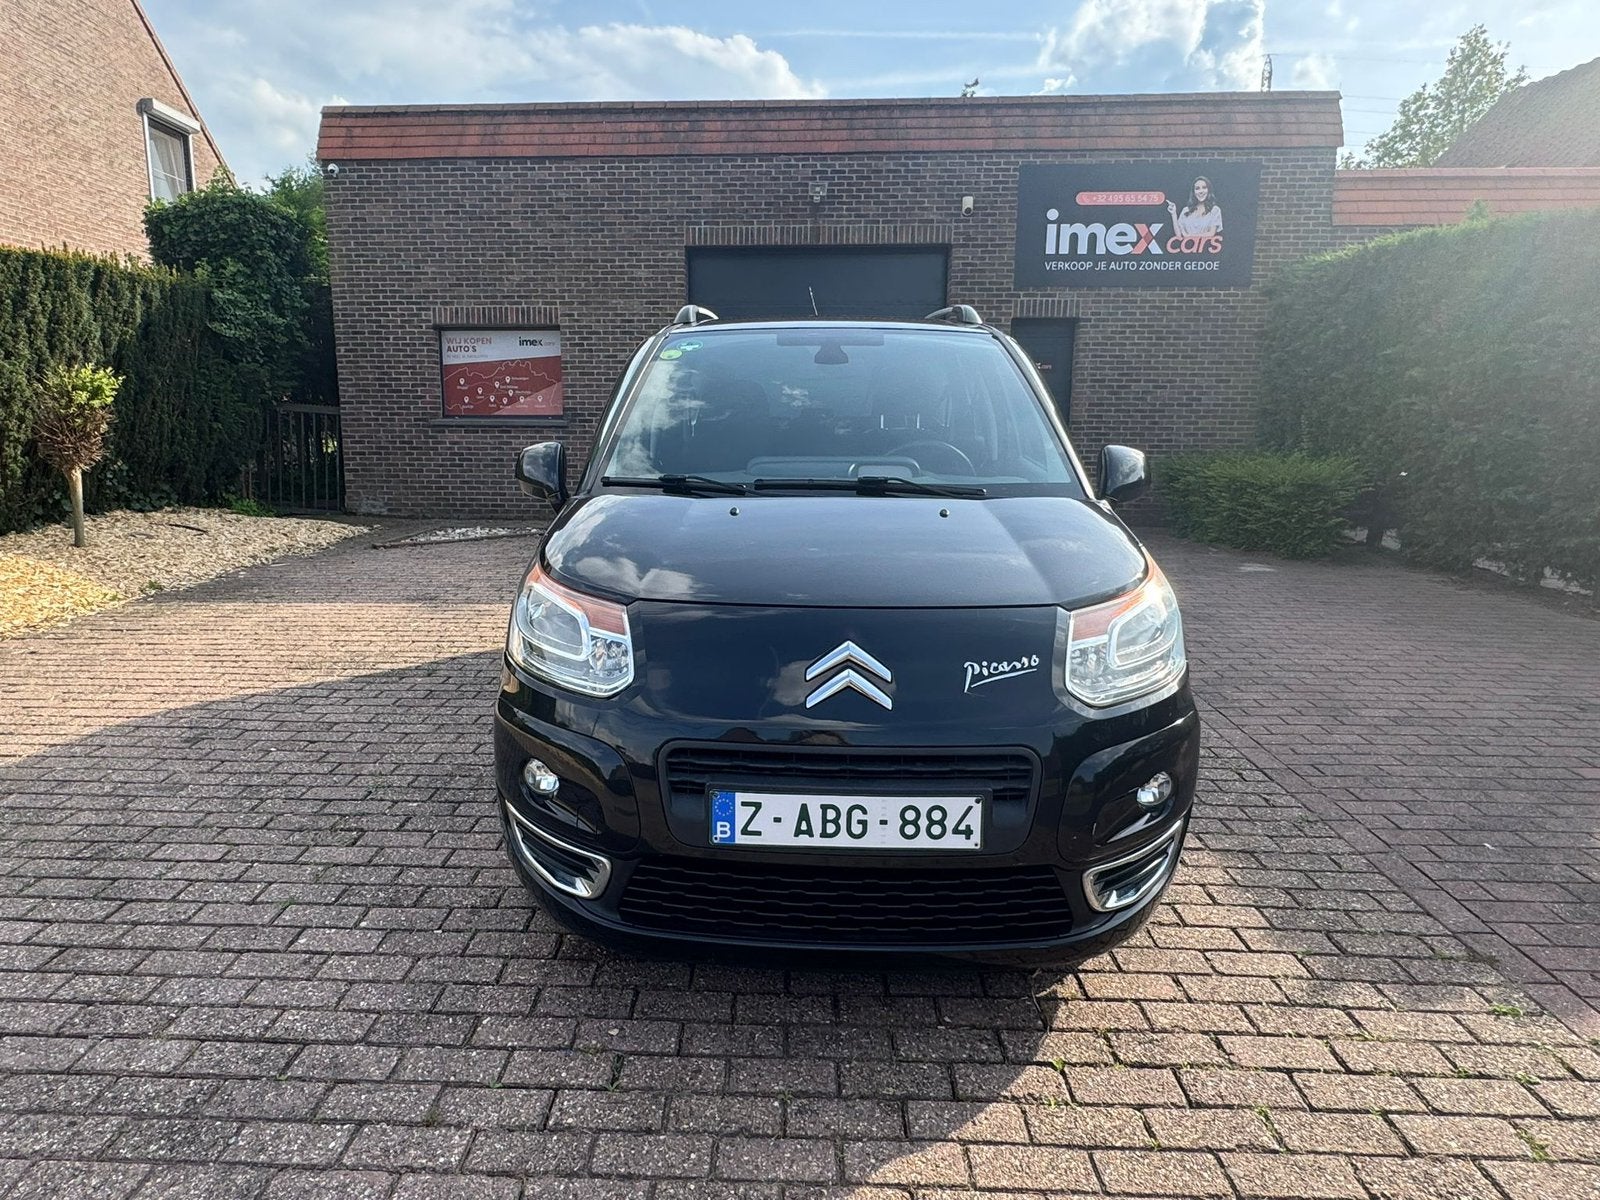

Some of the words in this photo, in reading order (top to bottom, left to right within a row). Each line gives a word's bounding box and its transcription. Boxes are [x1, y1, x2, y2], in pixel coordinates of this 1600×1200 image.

[1045, 208, 1164, 256] imex
[1166, 235, 1224, 254] cars
[1045, 261, 1093, 271] VERKOOP
[1095, 261, 1107, 271] JE
[1109, 261, 1137, 271] AUTO
[1139, 261, 1180, 271] ZONDER
[1183, 261, 1220, 271] GEDOE
[446, 337, 462, 345] WIJ
[463, 337, 493, 345] KOPEN
[518, 336, 543, 347] imex
[963, 654, 1040, 693] Picasso
[716, 821, 731, 838] B
